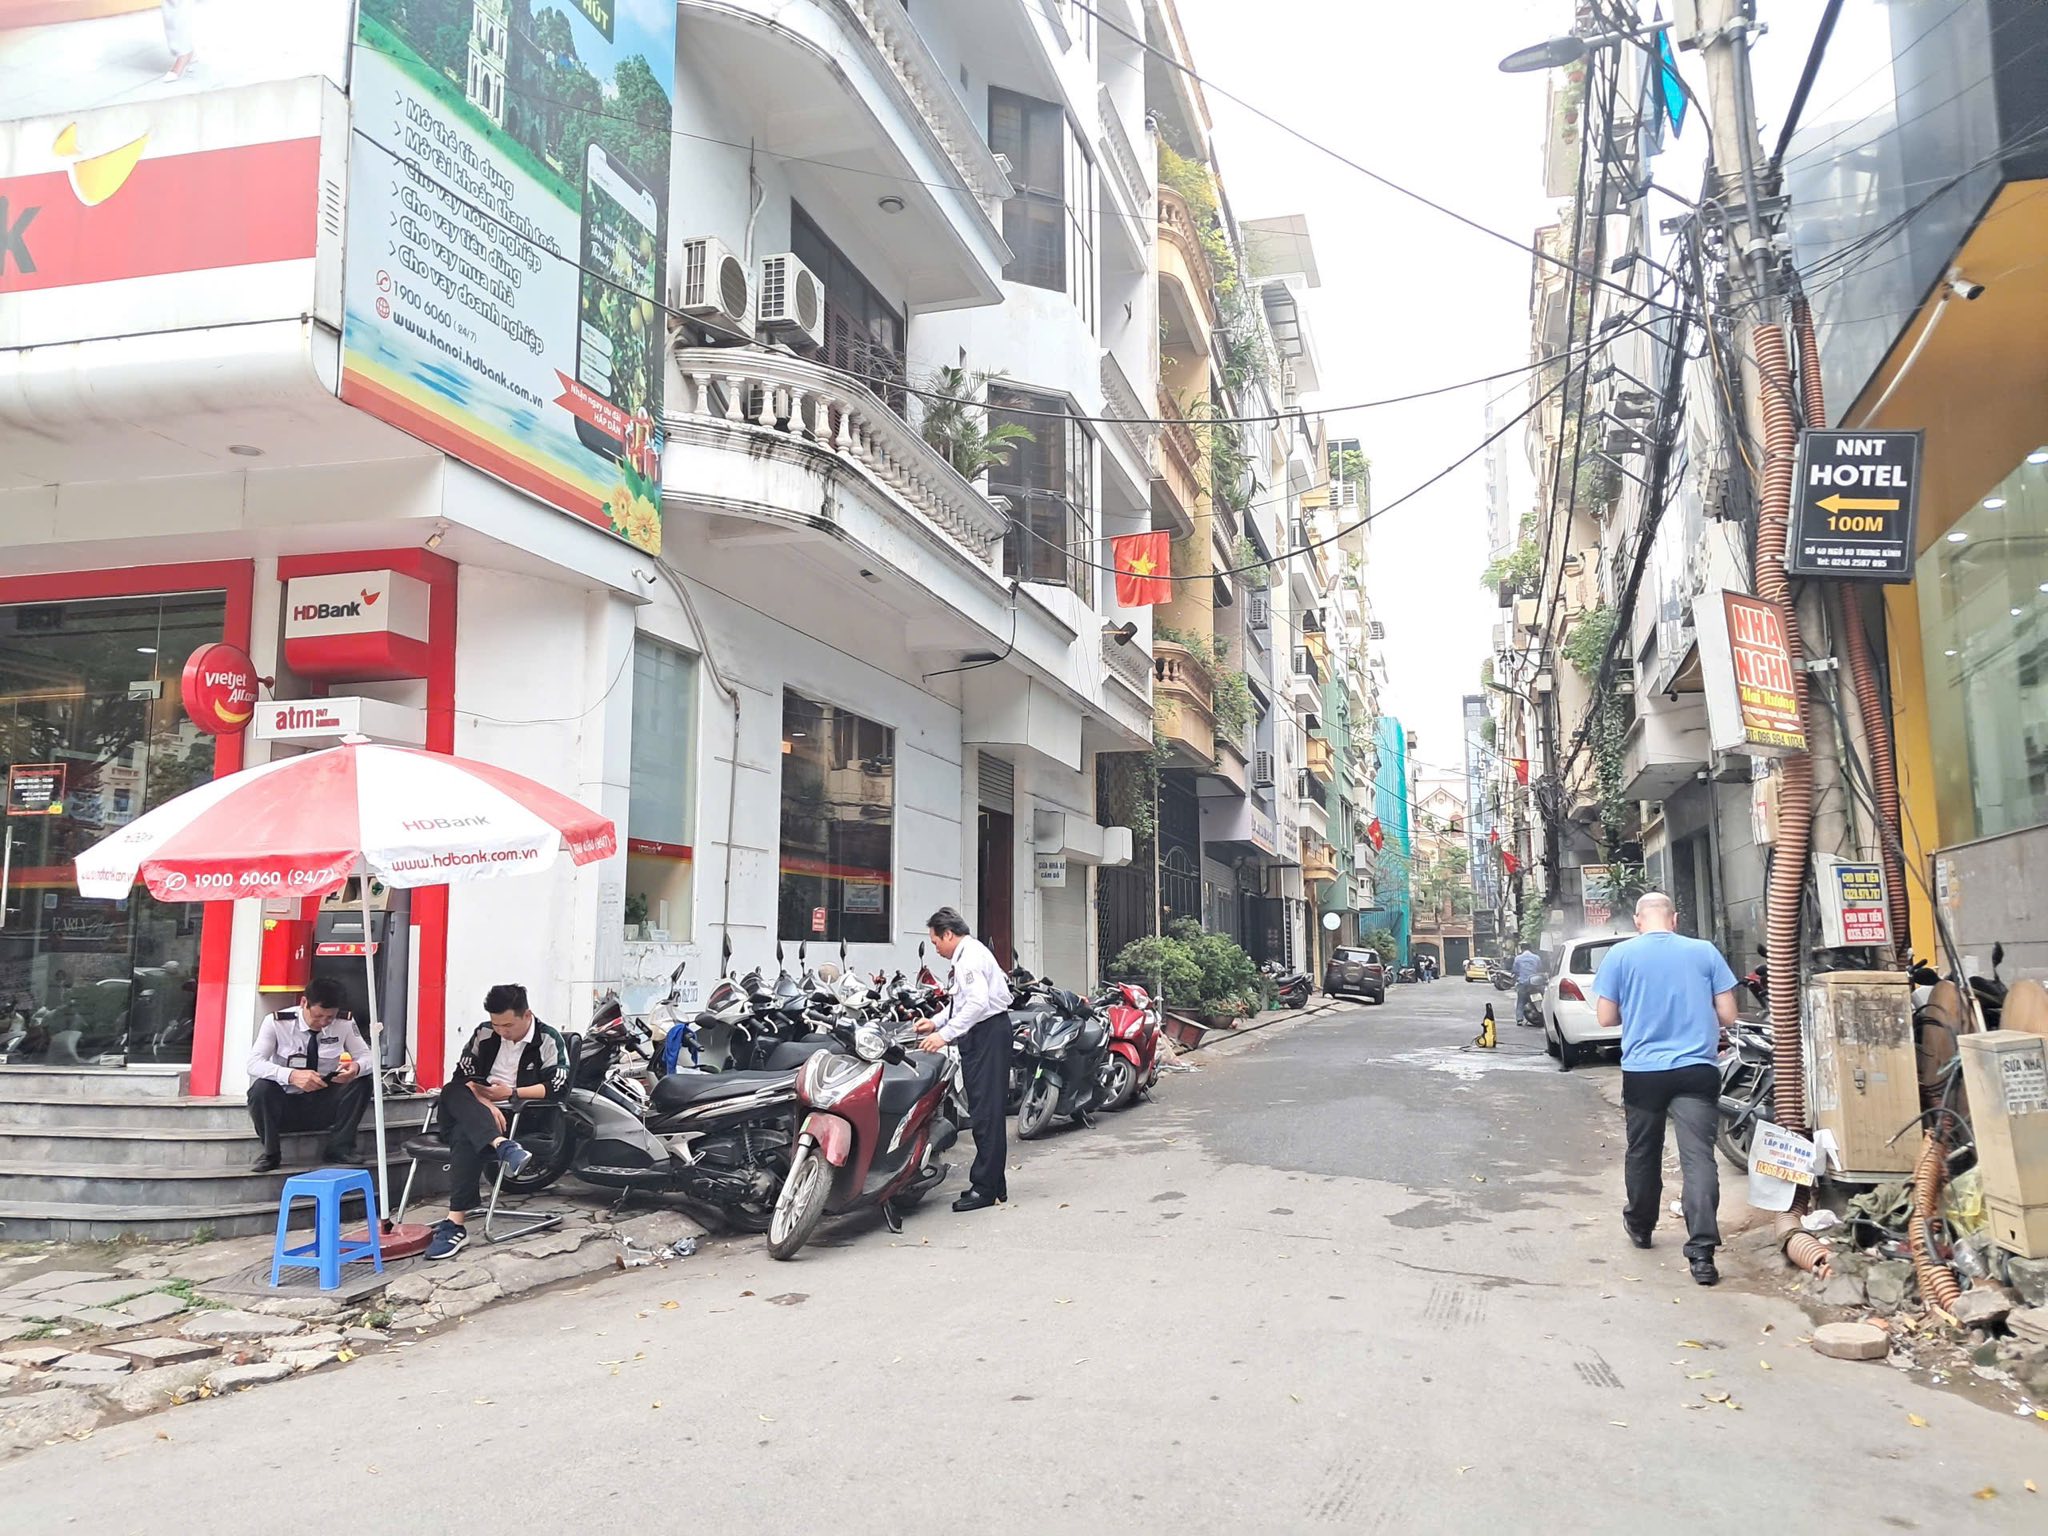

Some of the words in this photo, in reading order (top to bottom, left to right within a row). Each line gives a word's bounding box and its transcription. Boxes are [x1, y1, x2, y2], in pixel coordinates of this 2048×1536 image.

[406, 97, 433, 132] Mở
[433, 120, 458, 154] thẻ
[459, 141, 478, 171] tín
[480, 159, 514, 201] dụng
[405, 126, 431, 160] Mở
[432, 148, 451, 177] tài
[453, 163, 496, 211] khoản
[497, 199, 534, 240] thanh
[401, 186, 431, 222] Cho
[432, 209, 459, 244] vay
[460, 228, 487, 262] tiêu
[488, 248, 522, 288] dùng
[436, 181, 462, 215] vay
[499, 231, 542, 273] nghiệp
[400, 215, 430, 251] Cho
[431, 239, 458, 271] vay
[459, 258, 488, 291] mua
[490, 278, 515, 308] nhà
[393, 280, 422, 309] 1900
[424, 300, 452, 328] 6060
[399, 244, 429, 279] Cho
[430, 267, 457, 300] vay
[457, 284, 500, 327] doanh
[501, 314, 544, 356] nghiệp
[392, 311, 544, 409] www.hanoi.hdbank.com.vn
[1836, 439, 1887, 456] NNT
[1809, 464, 1908, 487] HOTEL
[1827, 515, 1883, 532] 100M
[293, 601, 362, 622] HDBank
[1732, 604, 1784, 651] NHÀ
[1734, 646, 1794, 694] NGHỈ
[276, 706, 314, 730] atm
[402, 814, 492, 832] HDBank
[194, 872, 233, 888] 1900
[239, 871, 281, 887] 6060
[287, 868, 335, 886] (24/7)
[392, 848, 539, 872] www.hdbank.com.vn
